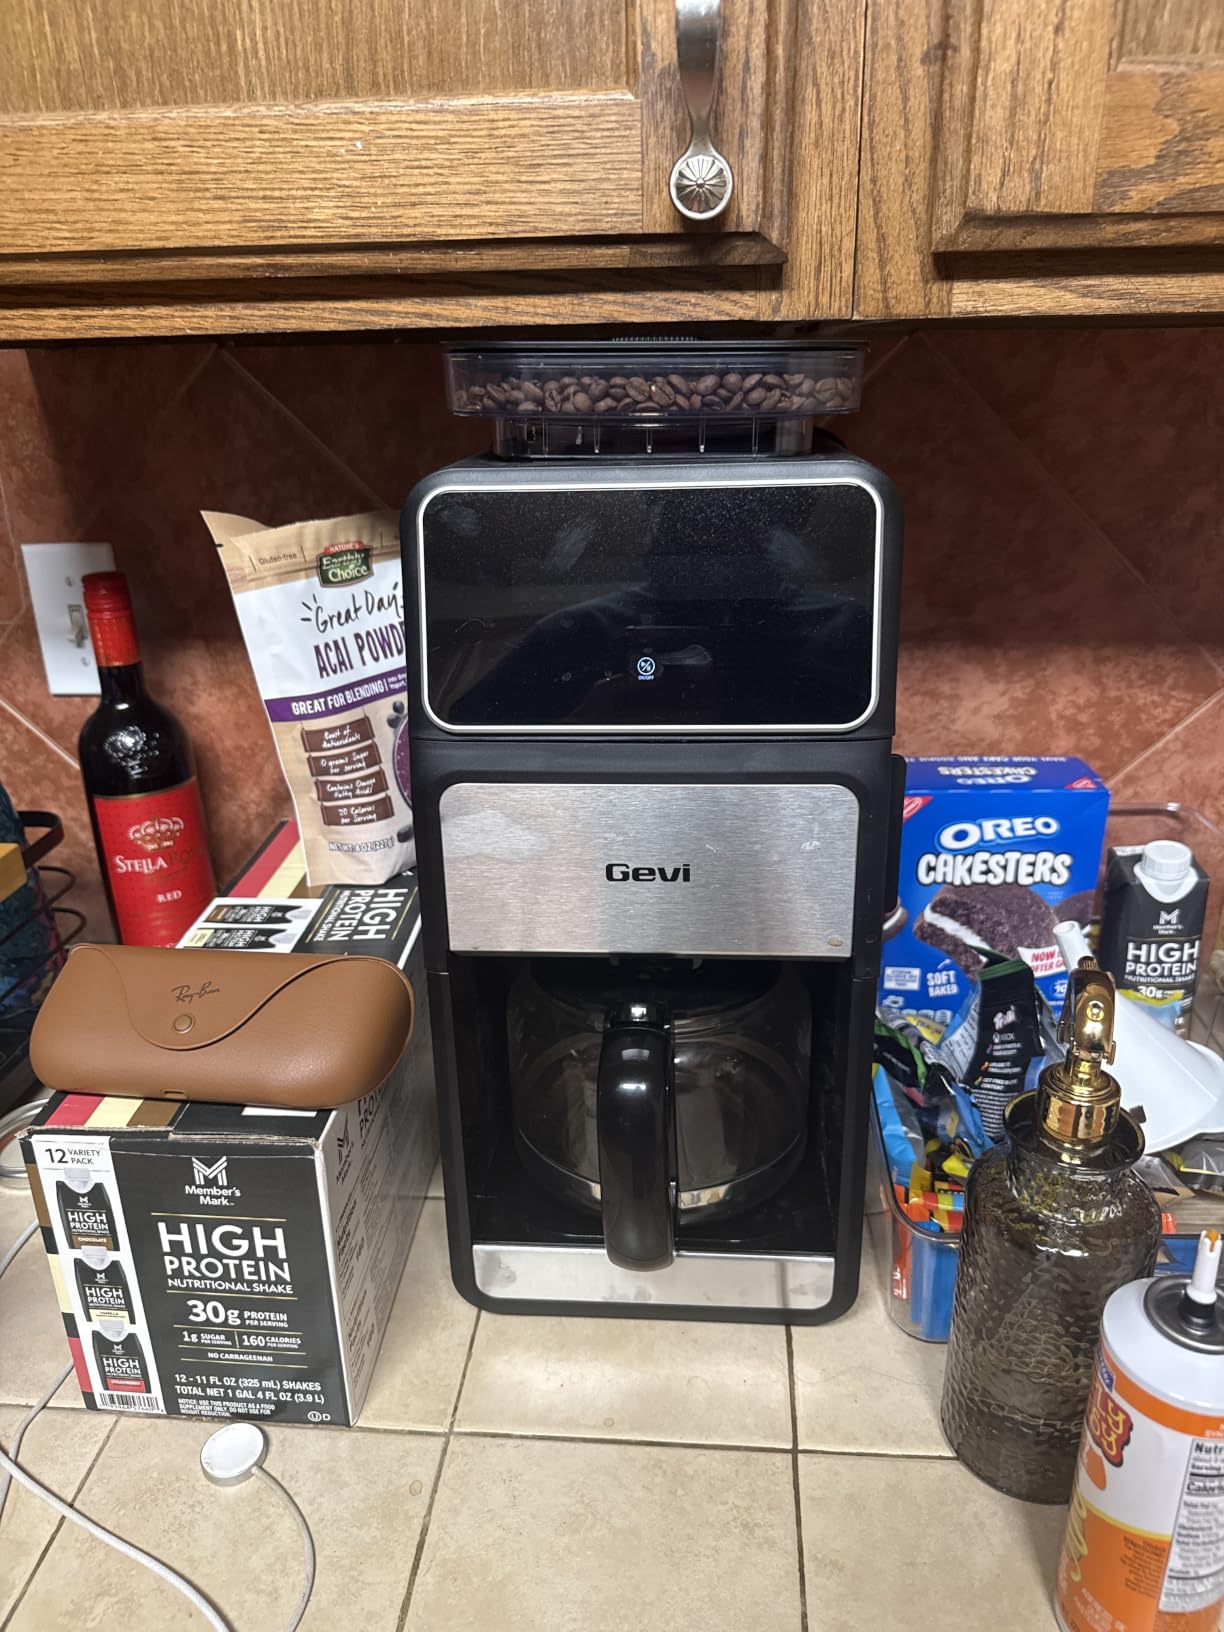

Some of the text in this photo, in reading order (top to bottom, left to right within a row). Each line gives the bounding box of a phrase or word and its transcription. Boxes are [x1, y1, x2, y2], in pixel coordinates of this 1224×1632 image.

[259, 552, 297, 566] Gluten-free
[329, 565, 368, 582] Choice
[314, 600, 361, 633] Great
[314, 637, 354, 679] ACAI
[291, 699, 326, 716] GREAT
[328, 694, 345, 709] FOR
[346, 680, 384, 704] BLENDING
[940, 816, 1058, 850] OREO
[606, 863, 690, 882] Gevi
[917, 851, 1073, 886] CAKESTERS
[156, 889, 182, 904] RED
[327, 889, 375, 941] PROTEIN
[352, 888, 409, 940] HIGH
[1031, 950, 1056, 962] NOW
[1127, 940, 1200, 962] HIGH
[1125, 960, 1197, 976] PROTEIN
[926, 970, 956, 985] SOFT
[928, 983, 958, 997] BAKED
[45, 1148, 69, 1164] 12
[67, 1148, 100, 1157] VARIETY
[71, 1157, 94, 1165] PACK
[185, 1185, 241, 1197] Member's
[200, 1196, 230, 1206] Mark
[67, 1211, 107, 1223] HIGH
[70, 1221, 109, 1230] PROTEIN
[158, 1222, 287, 1259] HIGH
[164, 1256, 291, 1282] PROTEIN
[85, 1287, 123, 1299] HIGH
[167, 1278, 293, 1294] NUTRITIONAL SHAKE
[88, 1297, 124, 1305] PROTEIN
[186, 1299, 242, 1325] 30g
[243, 1310, 288, 1321] PROTEIN
[259, 1320, 289, 1328] SERVING
[182, 1331, 199, 1343] 1g
[200, 1333, 226, 1341] SUGAR
[242, 1335, 266, 1346] 160
[266, 1336, 301, 1344] CALORIES
[103, 1357, 140, 1369] HIGH
[105, 1366, 141, 1375] PROTEIN
[175, 1374, 187, 1383] 12
[196, 1376, 207, 1384] 11
[210, 1376, 222, 1385] FL
[224, 1377, 237, 1386] OZ
[239, 1378, 260, 1388] (325
[262, 1380, 281, 1390] mL)
[283, 1381, 322, 1391] SHAKES
[175, 1386, 325, 1404] TOTAL NET 1 GAL 4 FL OZ (3.9 L)
